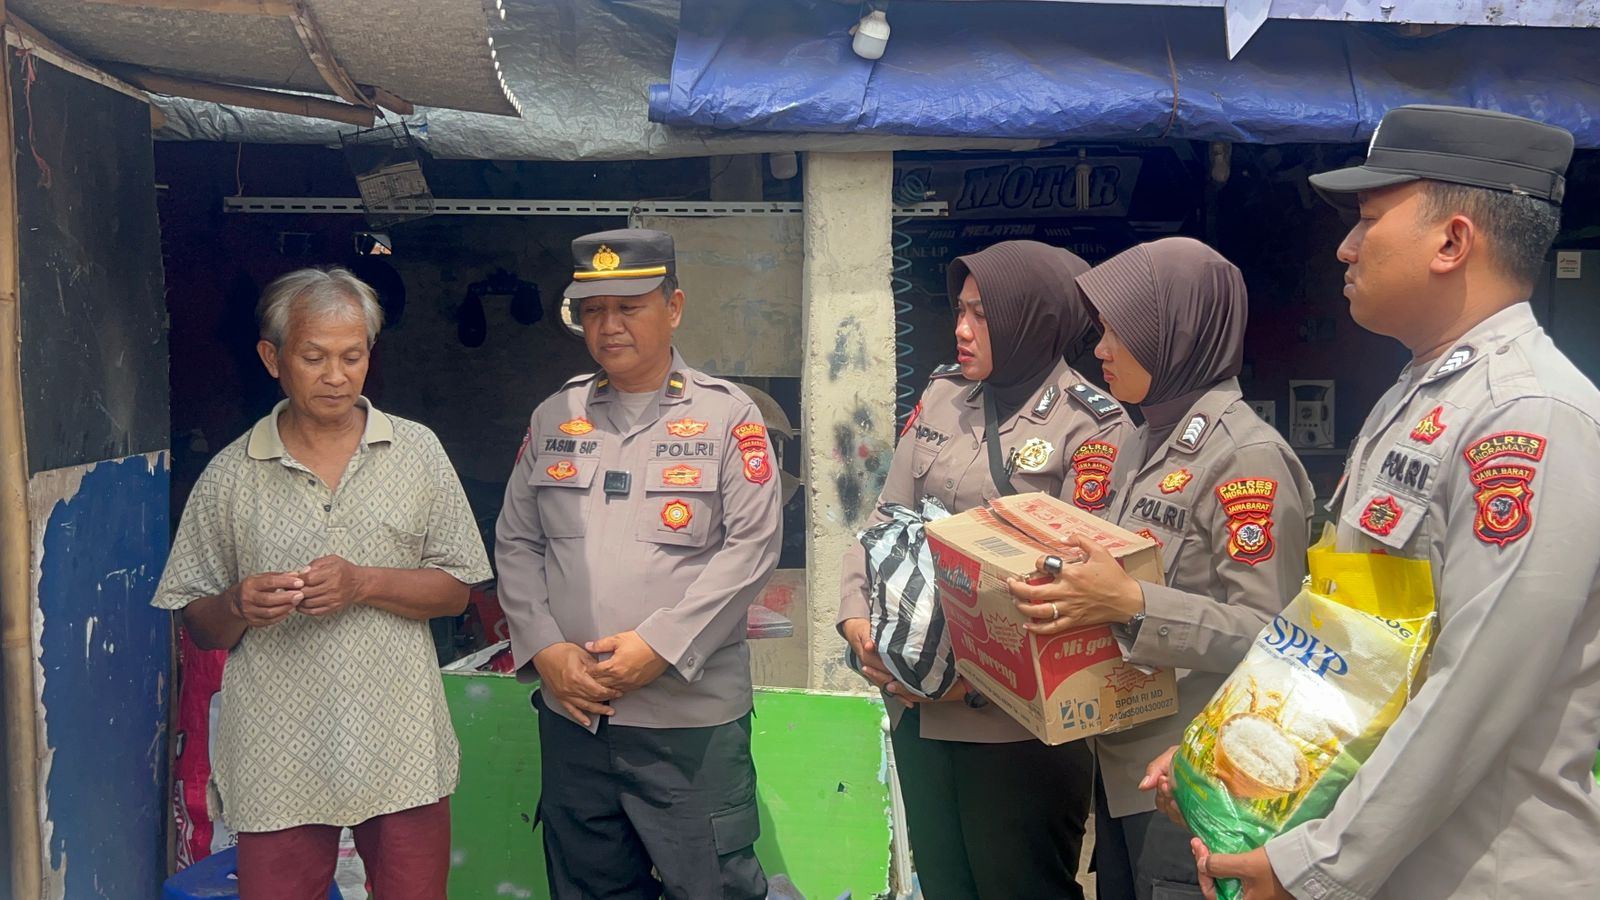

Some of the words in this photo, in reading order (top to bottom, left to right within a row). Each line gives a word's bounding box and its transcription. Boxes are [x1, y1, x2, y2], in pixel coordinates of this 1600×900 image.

[956, 164, 1121, 211] MOTOR
[544, 438, 577, 452] TASIM
[579, 441, 598, 455] SIP
[655, 442, 714, 457] POLRI
[1471, 435, 1540, 459] POLRES
[1473, 443, 1534, 464] INDRAMAYU
[1380, 450, 1430, 491] POLRI
[1475, 468, 1499, 481] JAWA
[1501, 467, 1530, 477] BARAT
[1219, 480, 1274, 496] POLRES
[1223, 488, 1271, 500] INDRAMAYU
[1132, 497, 1186, 530] POLRI
[1054, 638, 1084, 660] Mi
[1115, 694, 1140, 709] BPOM
[1140, 693, 1149, 702] RI
[1150, 688, 1164, 699] MD
